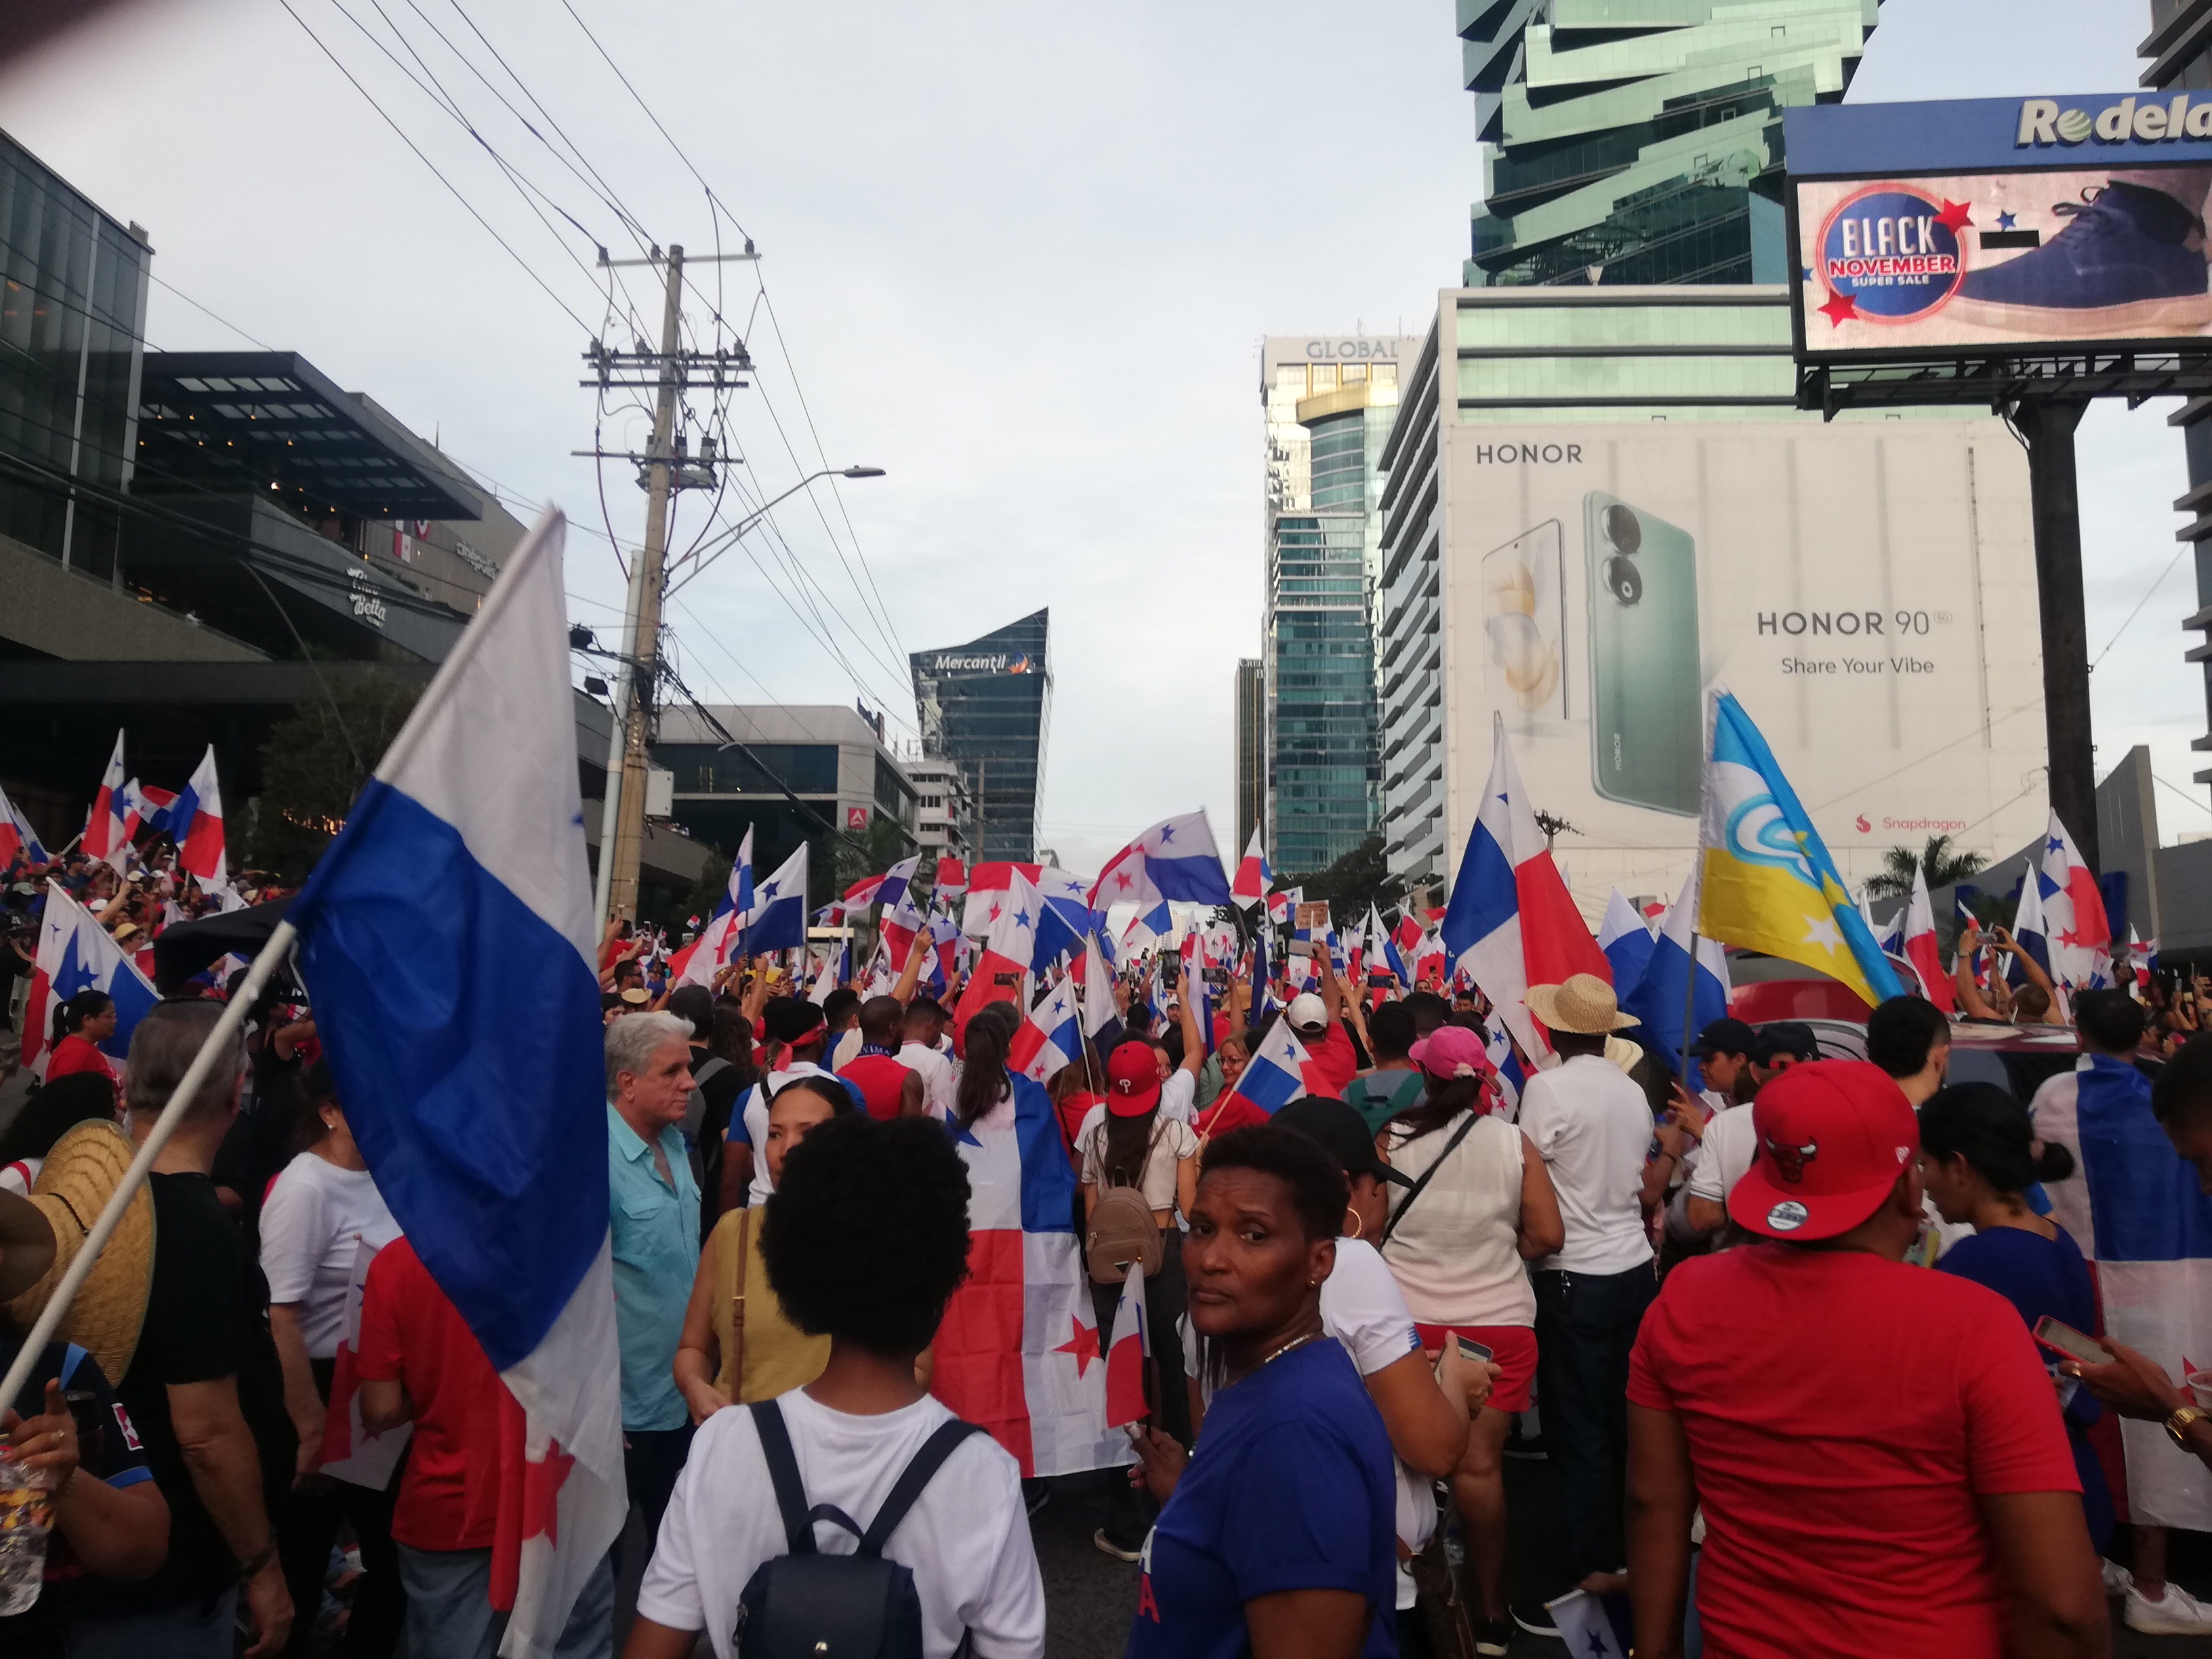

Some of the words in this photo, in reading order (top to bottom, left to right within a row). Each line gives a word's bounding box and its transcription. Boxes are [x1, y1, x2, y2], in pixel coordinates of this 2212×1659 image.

[1842, 215, 1938, 257] BLACK
[1828, 254, 1956, 278] NOVEMBER
[1851, 276, 1893, 287] SUPER
[1898, 274, 1929, 285] SALE
[1306, 340, 1398, 359] GLOBAL
[1476, 443, 1583, 464] HONOR
[1757, 611, 1885, 636] HONOR
[1895, 611, 1929, 635] 90
[935, 654, 1006, 670] Mercantil
[1781, 657, 1837, 674] Share
[1842, 657, 1885, 674] Your
[1889, 656, 1935, 674] Vibe
[1883, 816, 1967, 832] Snapdragon
